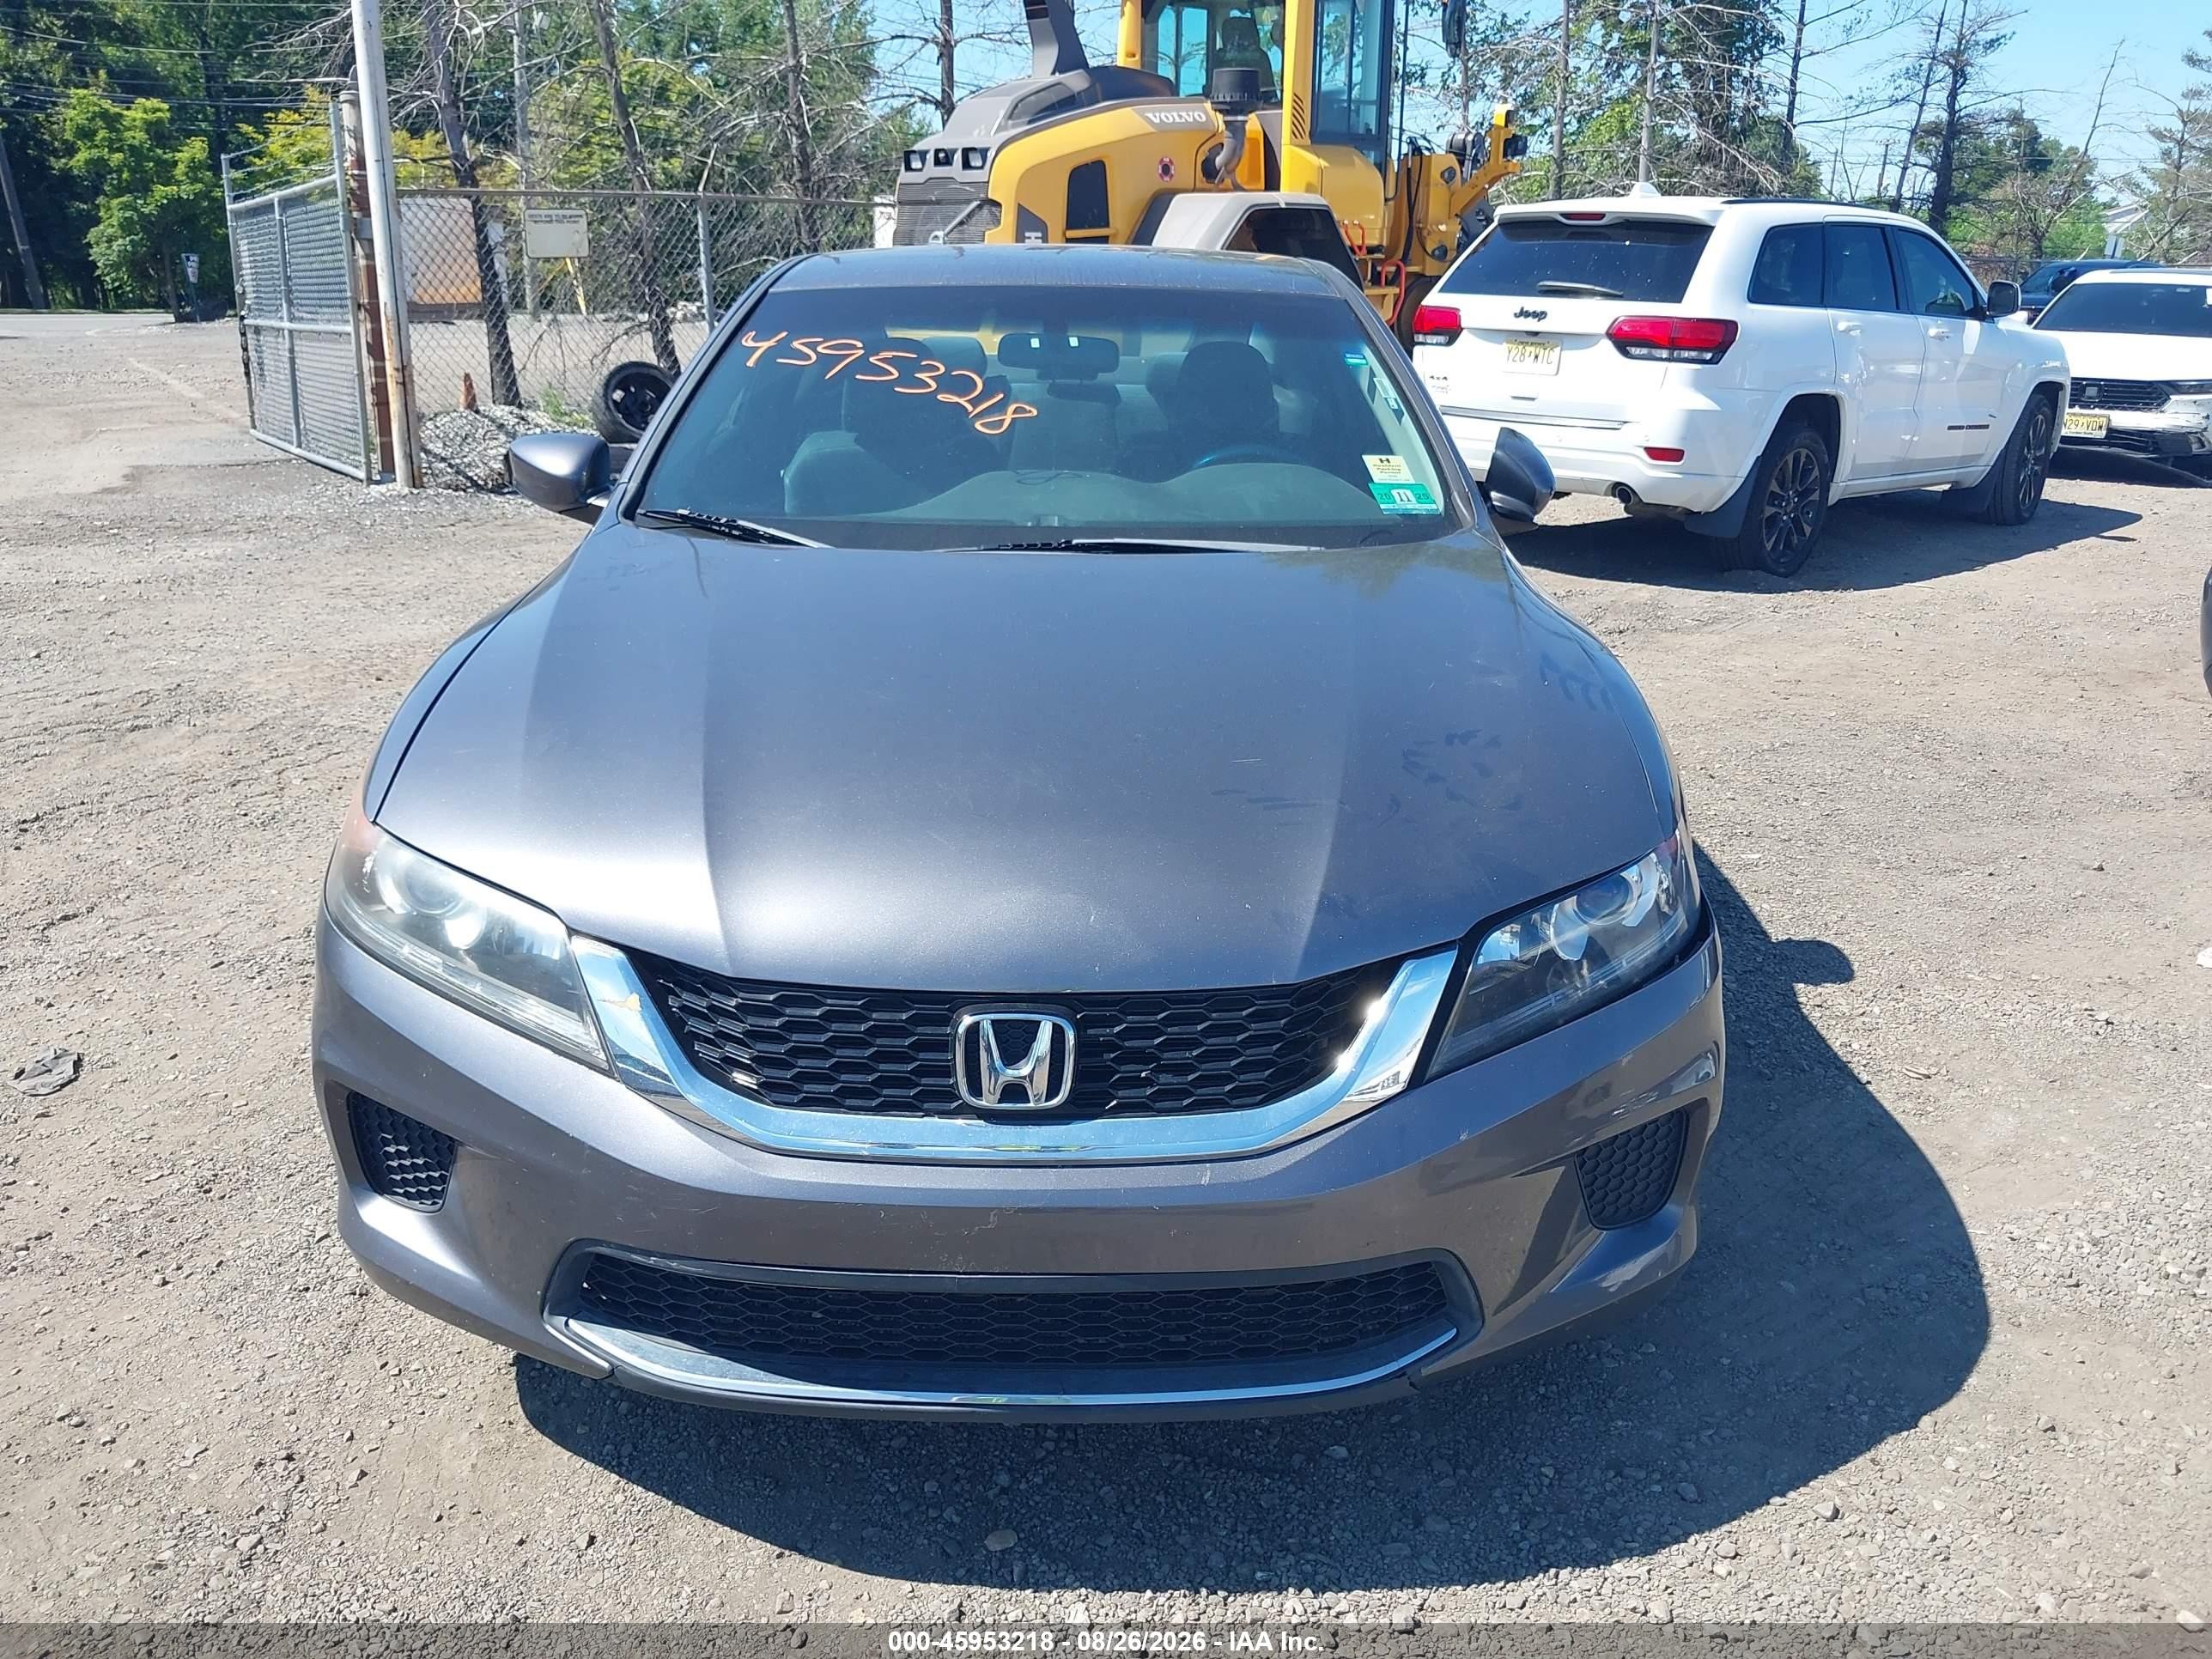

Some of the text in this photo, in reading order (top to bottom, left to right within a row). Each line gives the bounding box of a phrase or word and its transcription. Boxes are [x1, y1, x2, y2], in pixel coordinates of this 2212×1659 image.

[1144, 111, 1206, 124] VOLVO
[1513, 306, 1547, 322] Jeep
[1507, 344, 1554, 365] Y28 WTC
[742, 331, 1038, 434] 45953218
[1396, 491, 1413, 502] 11
